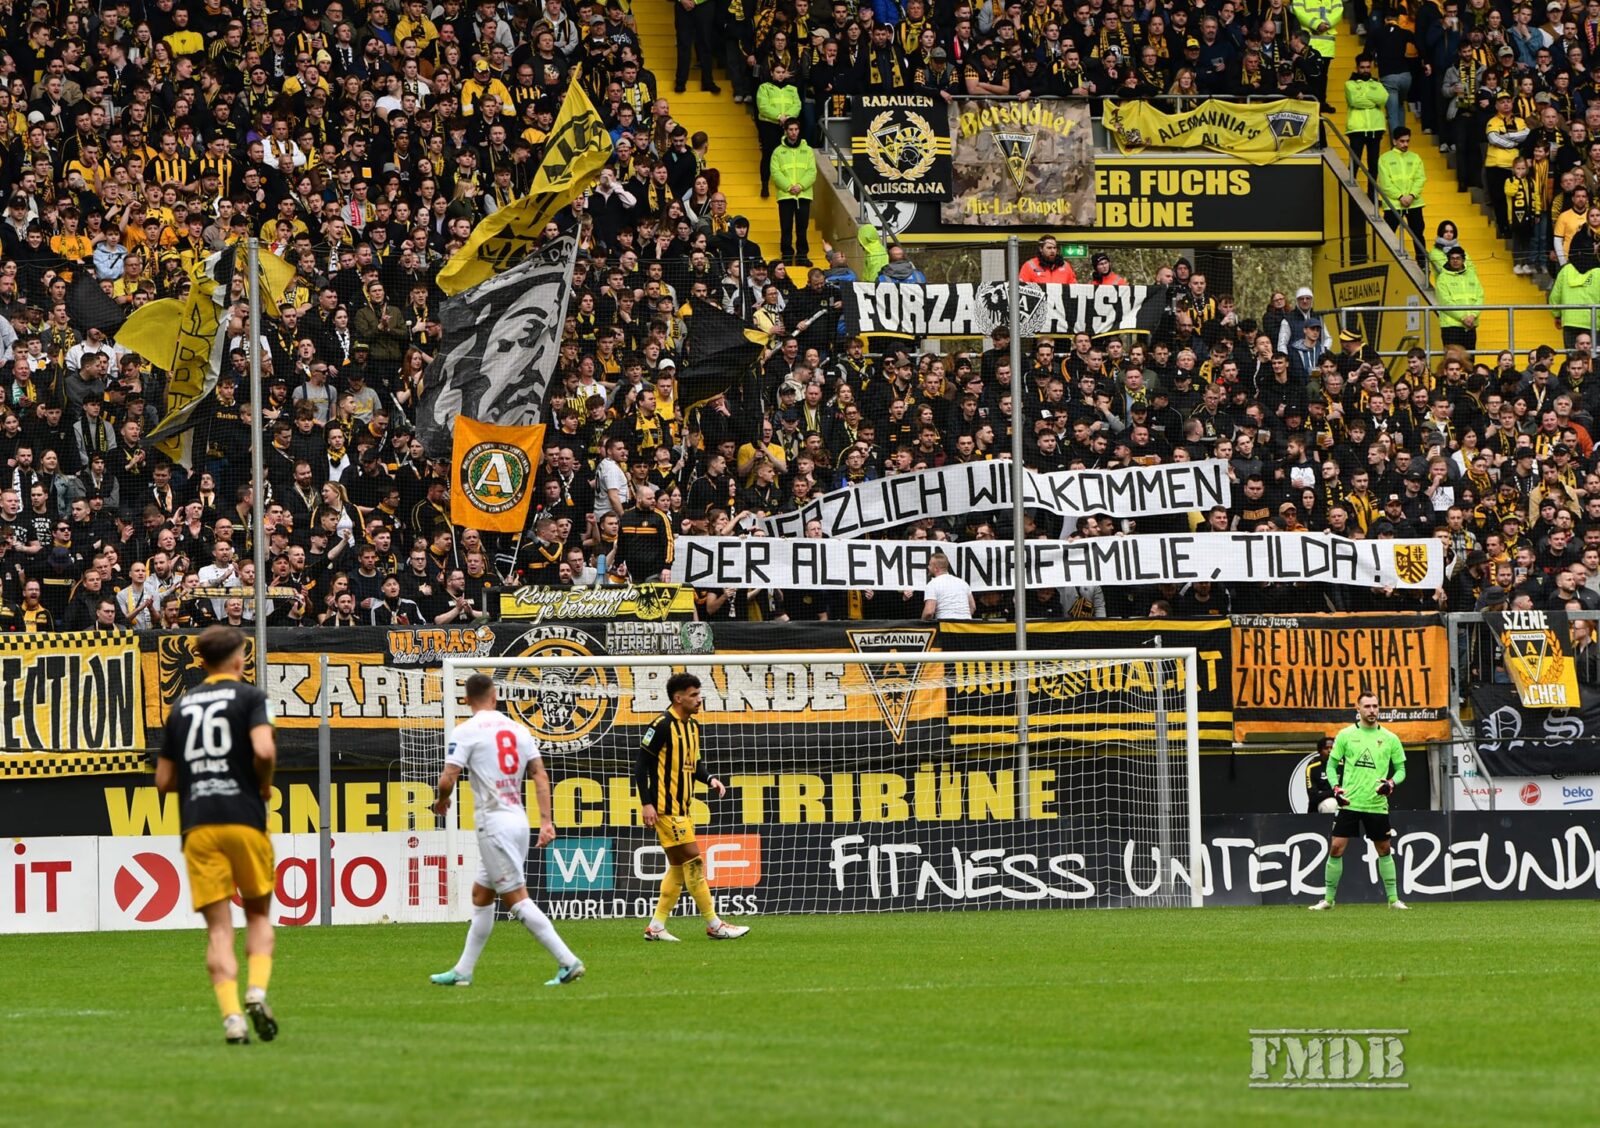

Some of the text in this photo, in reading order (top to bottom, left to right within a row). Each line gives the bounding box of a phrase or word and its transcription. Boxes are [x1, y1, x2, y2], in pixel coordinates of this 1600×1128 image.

[862, 96, 934, 107] RABAUKEN
[960, 102, 1076, 138] Biersöldner
[1140, 169, 1251, 196] FUCHS
[1339, 281, 1380, 302] ALEMANNIA
[852, 281, 1147, 335] FORZA ATSV
[475, 453, 513, 493] A
[685, 541, 770, 584] DER
[514, 583, 639, 605] Keine Sekunde
[531, 601, 619, 624] je bereut!
[1253, 617, 1267, 627] die
[1269, 617, 1298, 629] Jungs,
[1502, 610, 1549, 629] SZENE
[526, 625, 588, 646] KARLS
[607, 622, 680, 634] LEGENDEN
[859, 634, 926, 645] ALEMANNIA
[387, 629, 478, 654] ULTRAS
[606, 635, 682, 650] STERBEN NIE!
[1239, 628, 1426, 667] FREUNDSCHAFT
[1525, 641, 1537, 654] A
[0, 650, 135, 750] ECTION
[630, 663, 847, 713] BANDE
[1236, 667, 1431, 708] ZUSAMMENHALT
[181, 700, 232, 762] 26
[496, 730, 519, 775] 8
[104, 781, 435, 836] WNER
[730, 763, 1058, 824] TRIBÜNE
[1563, 787, 1593, 798] beko
[829, 826, 1600, 901] FITNESS UNTER FREUND
[549, 899, 626, 920] WORLD
[668, 894, 759, 916] FITESS
